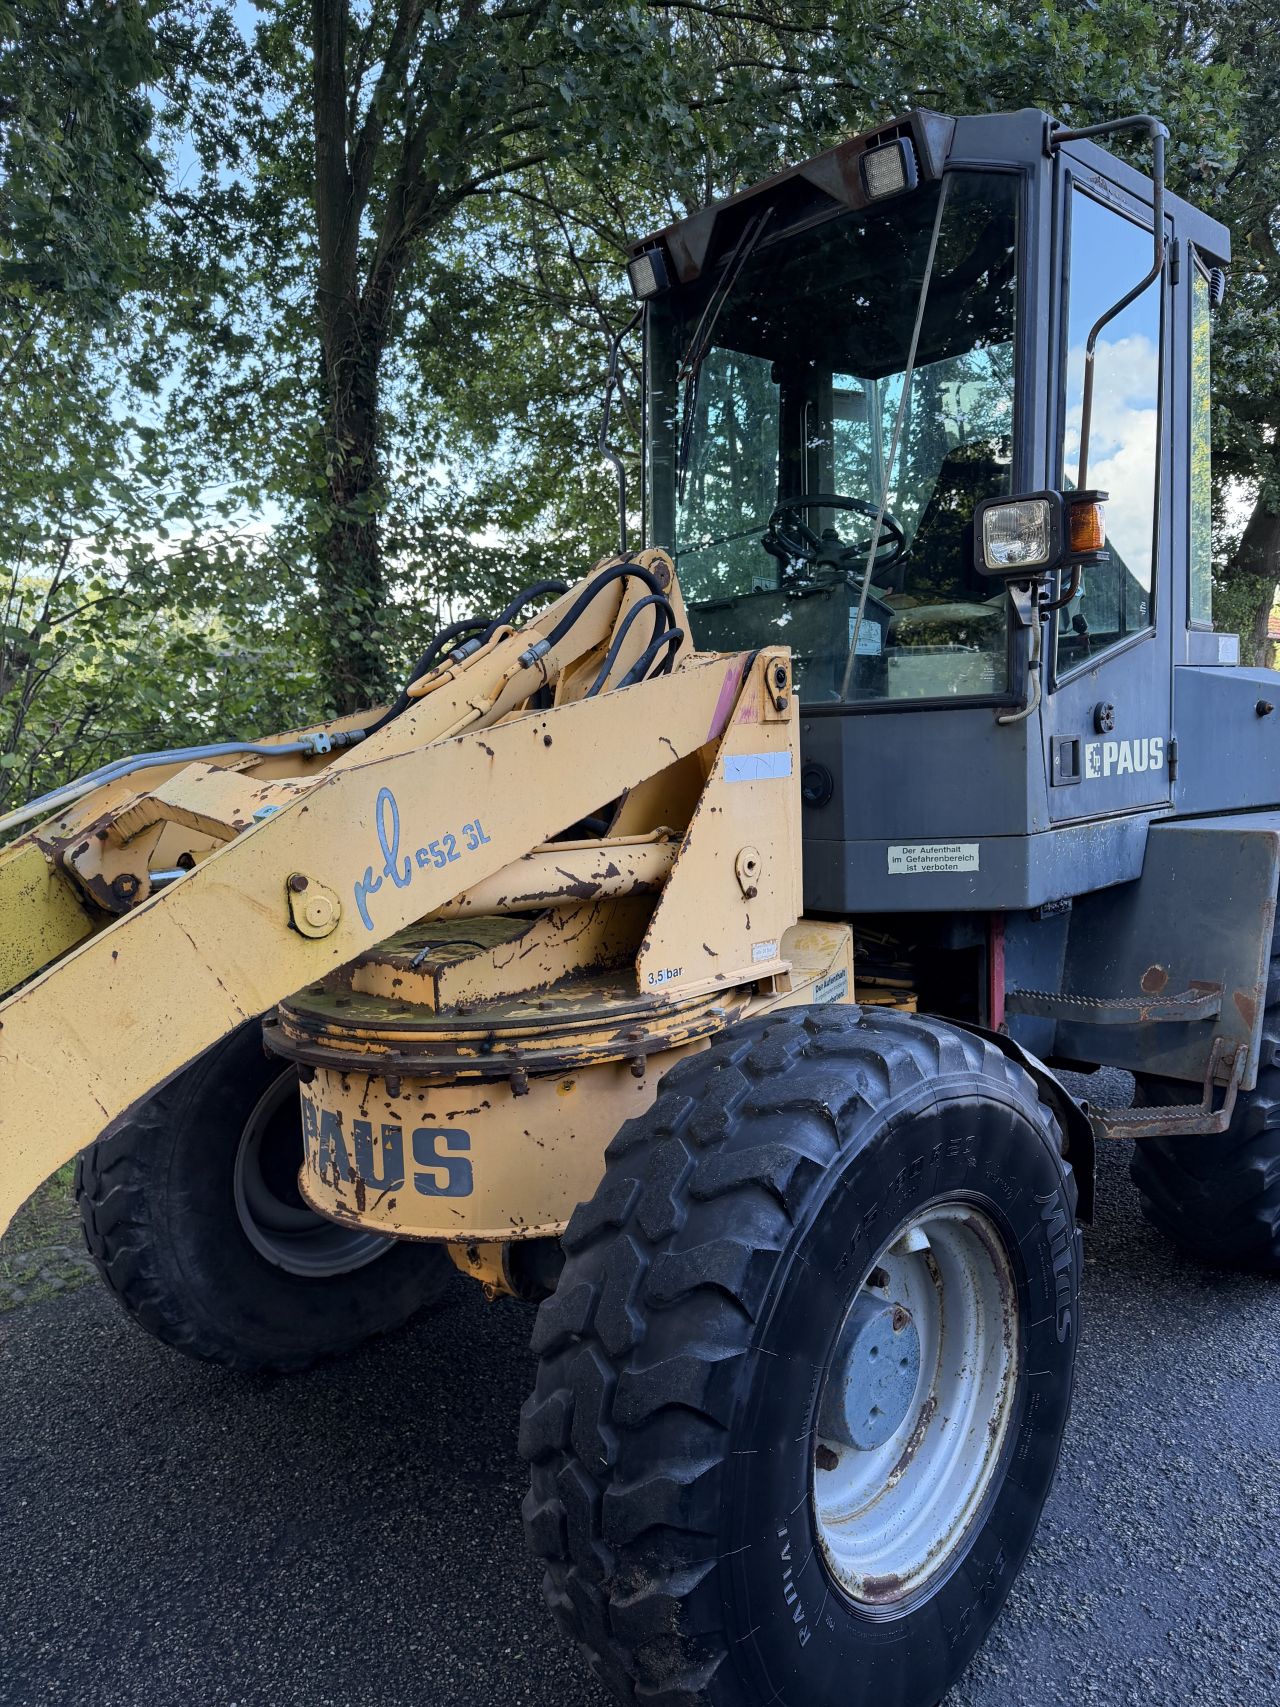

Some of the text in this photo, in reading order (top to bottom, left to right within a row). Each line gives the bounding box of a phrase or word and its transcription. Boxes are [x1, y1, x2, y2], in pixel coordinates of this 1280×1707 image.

[1103, 736, 1163, 777] PAUS
[902, 846, 961, 855] Der Aufenthalt
[905, 854, 975, 863] Gefahrenbereich
[921, 863, 959, 871] verboten
[648, 966, 683, 985] 3,5 bar
[301, 1092, 474, 1198] PAUS
[776, 1518, 812, 1648] RADIAL
